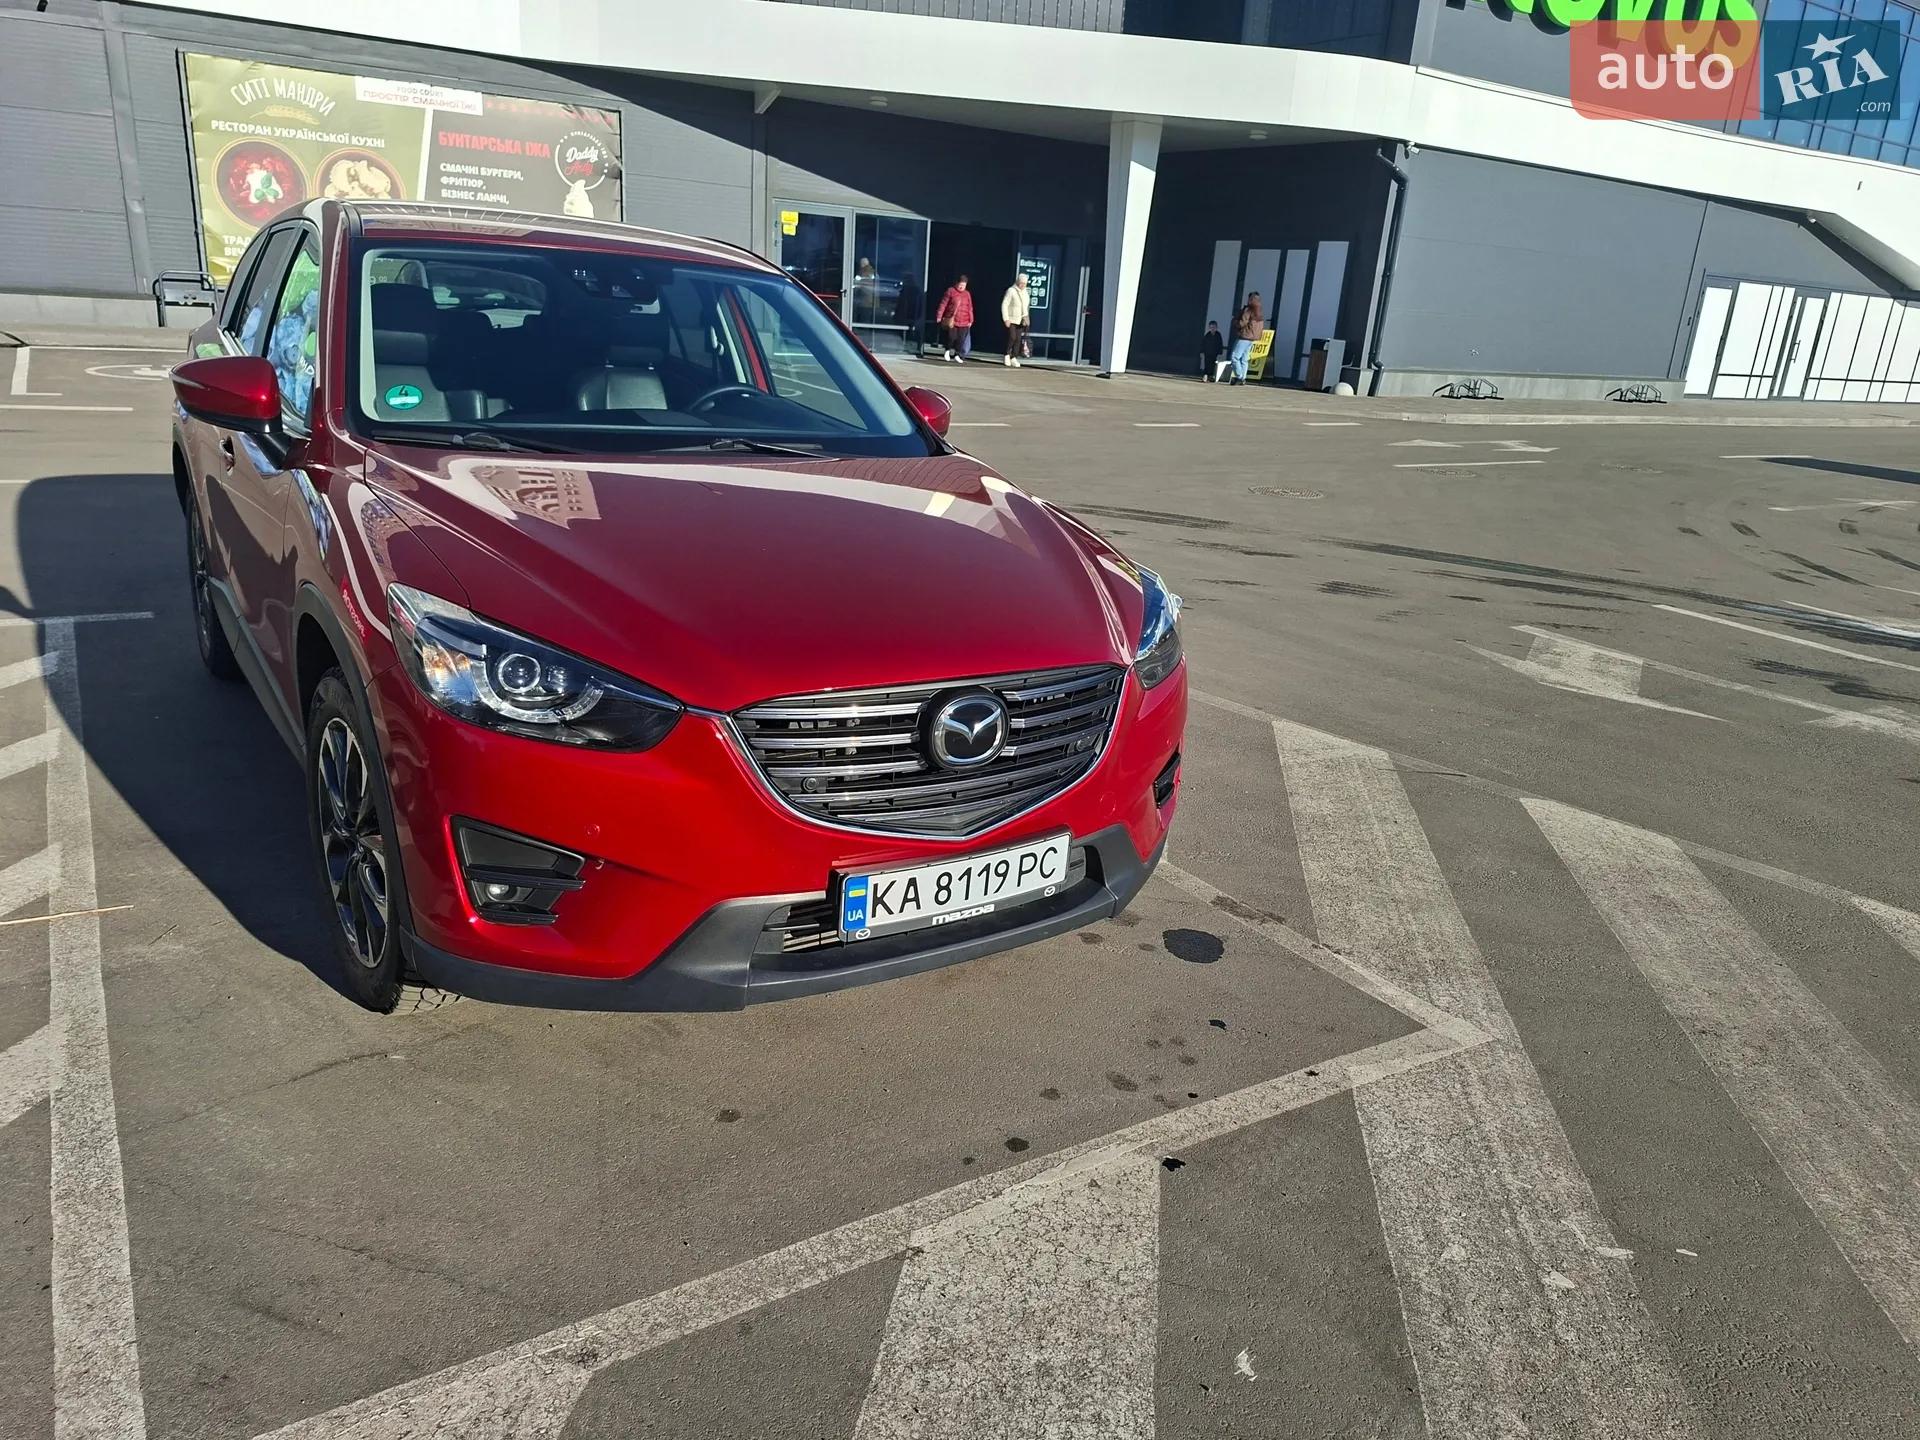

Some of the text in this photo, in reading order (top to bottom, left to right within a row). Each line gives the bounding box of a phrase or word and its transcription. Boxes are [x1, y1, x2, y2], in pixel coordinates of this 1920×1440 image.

[230, 77, 336, 116] СИТІ МАНДРИ
[211, 120, 386, 148] РЕСТОРАН УКРАЇНСЬКОЇ КУХНІ
[438, 131, 522, 155] БУНТАРСЬКА
[440, 163, 479, 176] СМАЧНІ
[440, 176, 486, 190] ФРИТЮР,
[441, 189, 475, 201] БІЗНЕС
[398, 386, 409, 396] 4
[871, 846, 1058, 918] KA 8119 PC
[847, 910, 864, 922] UA
[932, 903, 995, 926] mazda
